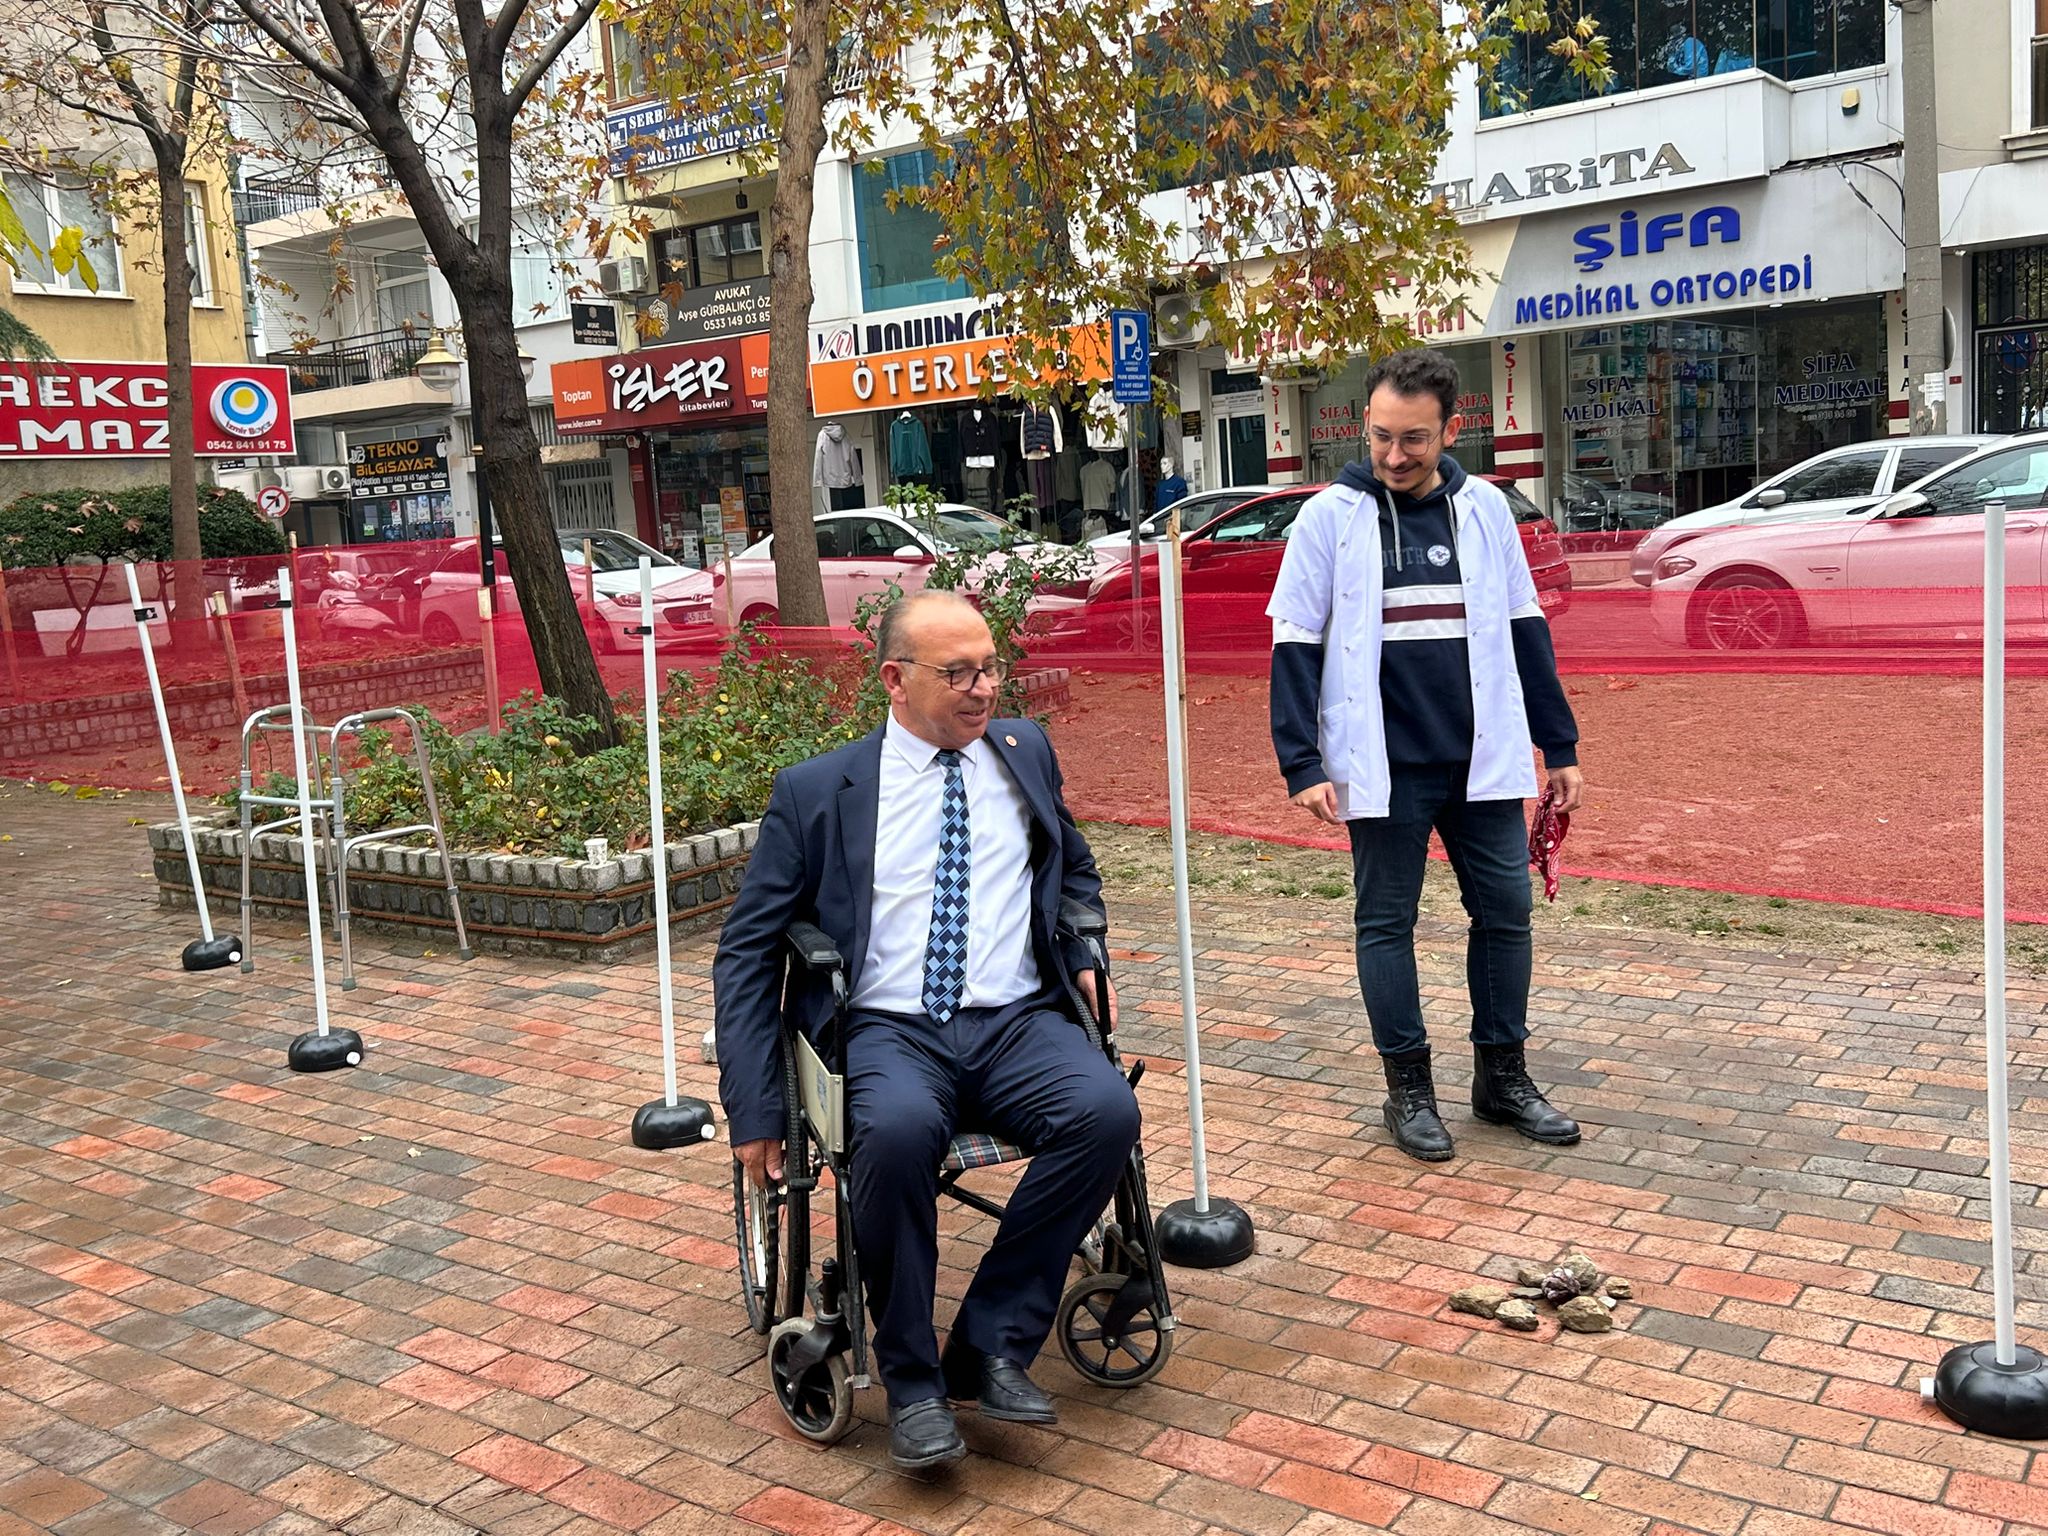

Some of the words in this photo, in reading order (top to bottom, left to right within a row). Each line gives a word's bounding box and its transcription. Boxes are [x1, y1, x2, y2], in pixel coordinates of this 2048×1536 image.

[1573, 205, 1740, 273] ŞİFA
[715, 285, 751, 302] AVUKAT
[1515, 283, 1640, 325] MEDİKAL
[1650, 254, 1812, 306] ORTOPEDİ
[677, 310, 698, 322] Ayşe
[699, 299, 755, 318] GÜRBALIKÇI
[703, 317, 726, 331] 0533
[728, 314, 743, 327] 149
[745, 313, 757, 325] 03
[759, 311, 770, 323] 85
[1118, 317, 1138, 361] P
[1802, 350, 1855, 380] ŞİFA
[562, 390, 592, 405] Toptan
[1586, 373, 1632, 402] ŞİFA
[1773, 376, 1886, 405] MEDİKAL
[679, 398, 728, 413] Kitabevleri
[1561, 397, 1661, 423] MEDİKAL
[206, 440, 233, 450] 0542
[236, 440, 254, 450] 841
[258, 440, 270, 450] 91
[273, 440, 287, 450] 75
[366, 439, 419, 459] TEKNO
